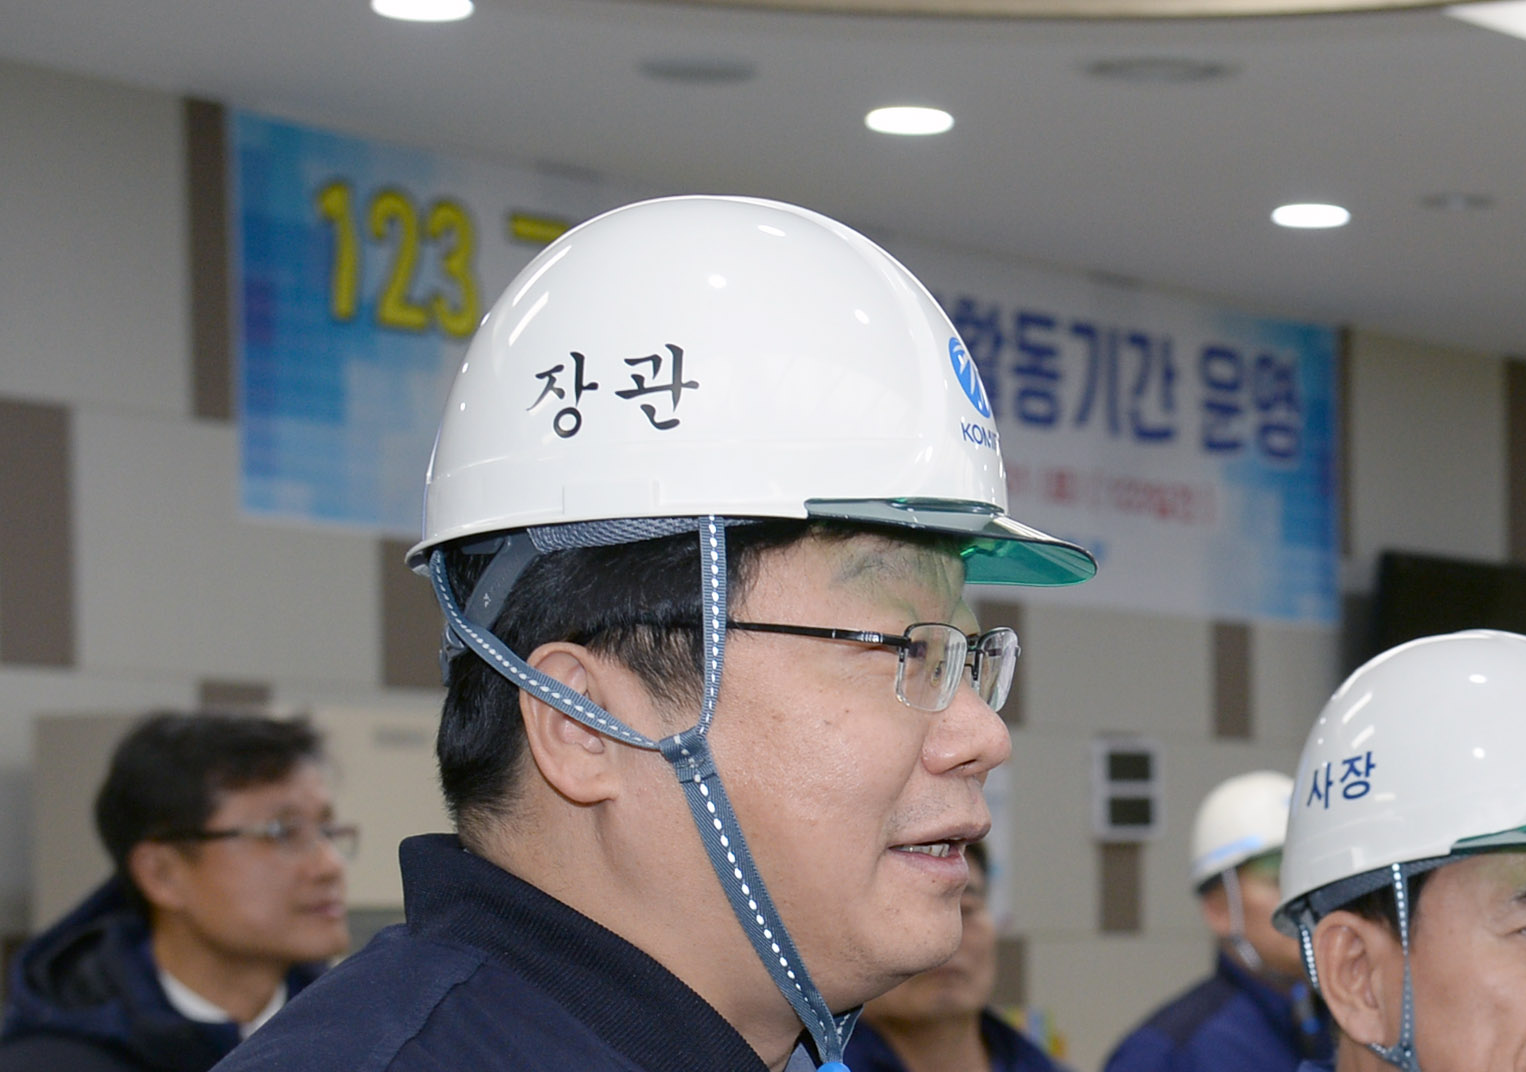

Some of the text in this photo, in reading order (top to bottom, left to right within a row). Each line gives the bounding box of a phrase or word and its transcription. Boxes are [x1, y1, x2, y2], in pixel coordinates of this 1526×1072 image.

[316, 180, 478, 338] 123
[527, 343, 700, 438] 장관
[1202, 344, 1300, 461] 운영
[1307, 751, 1375, 809] 사장
